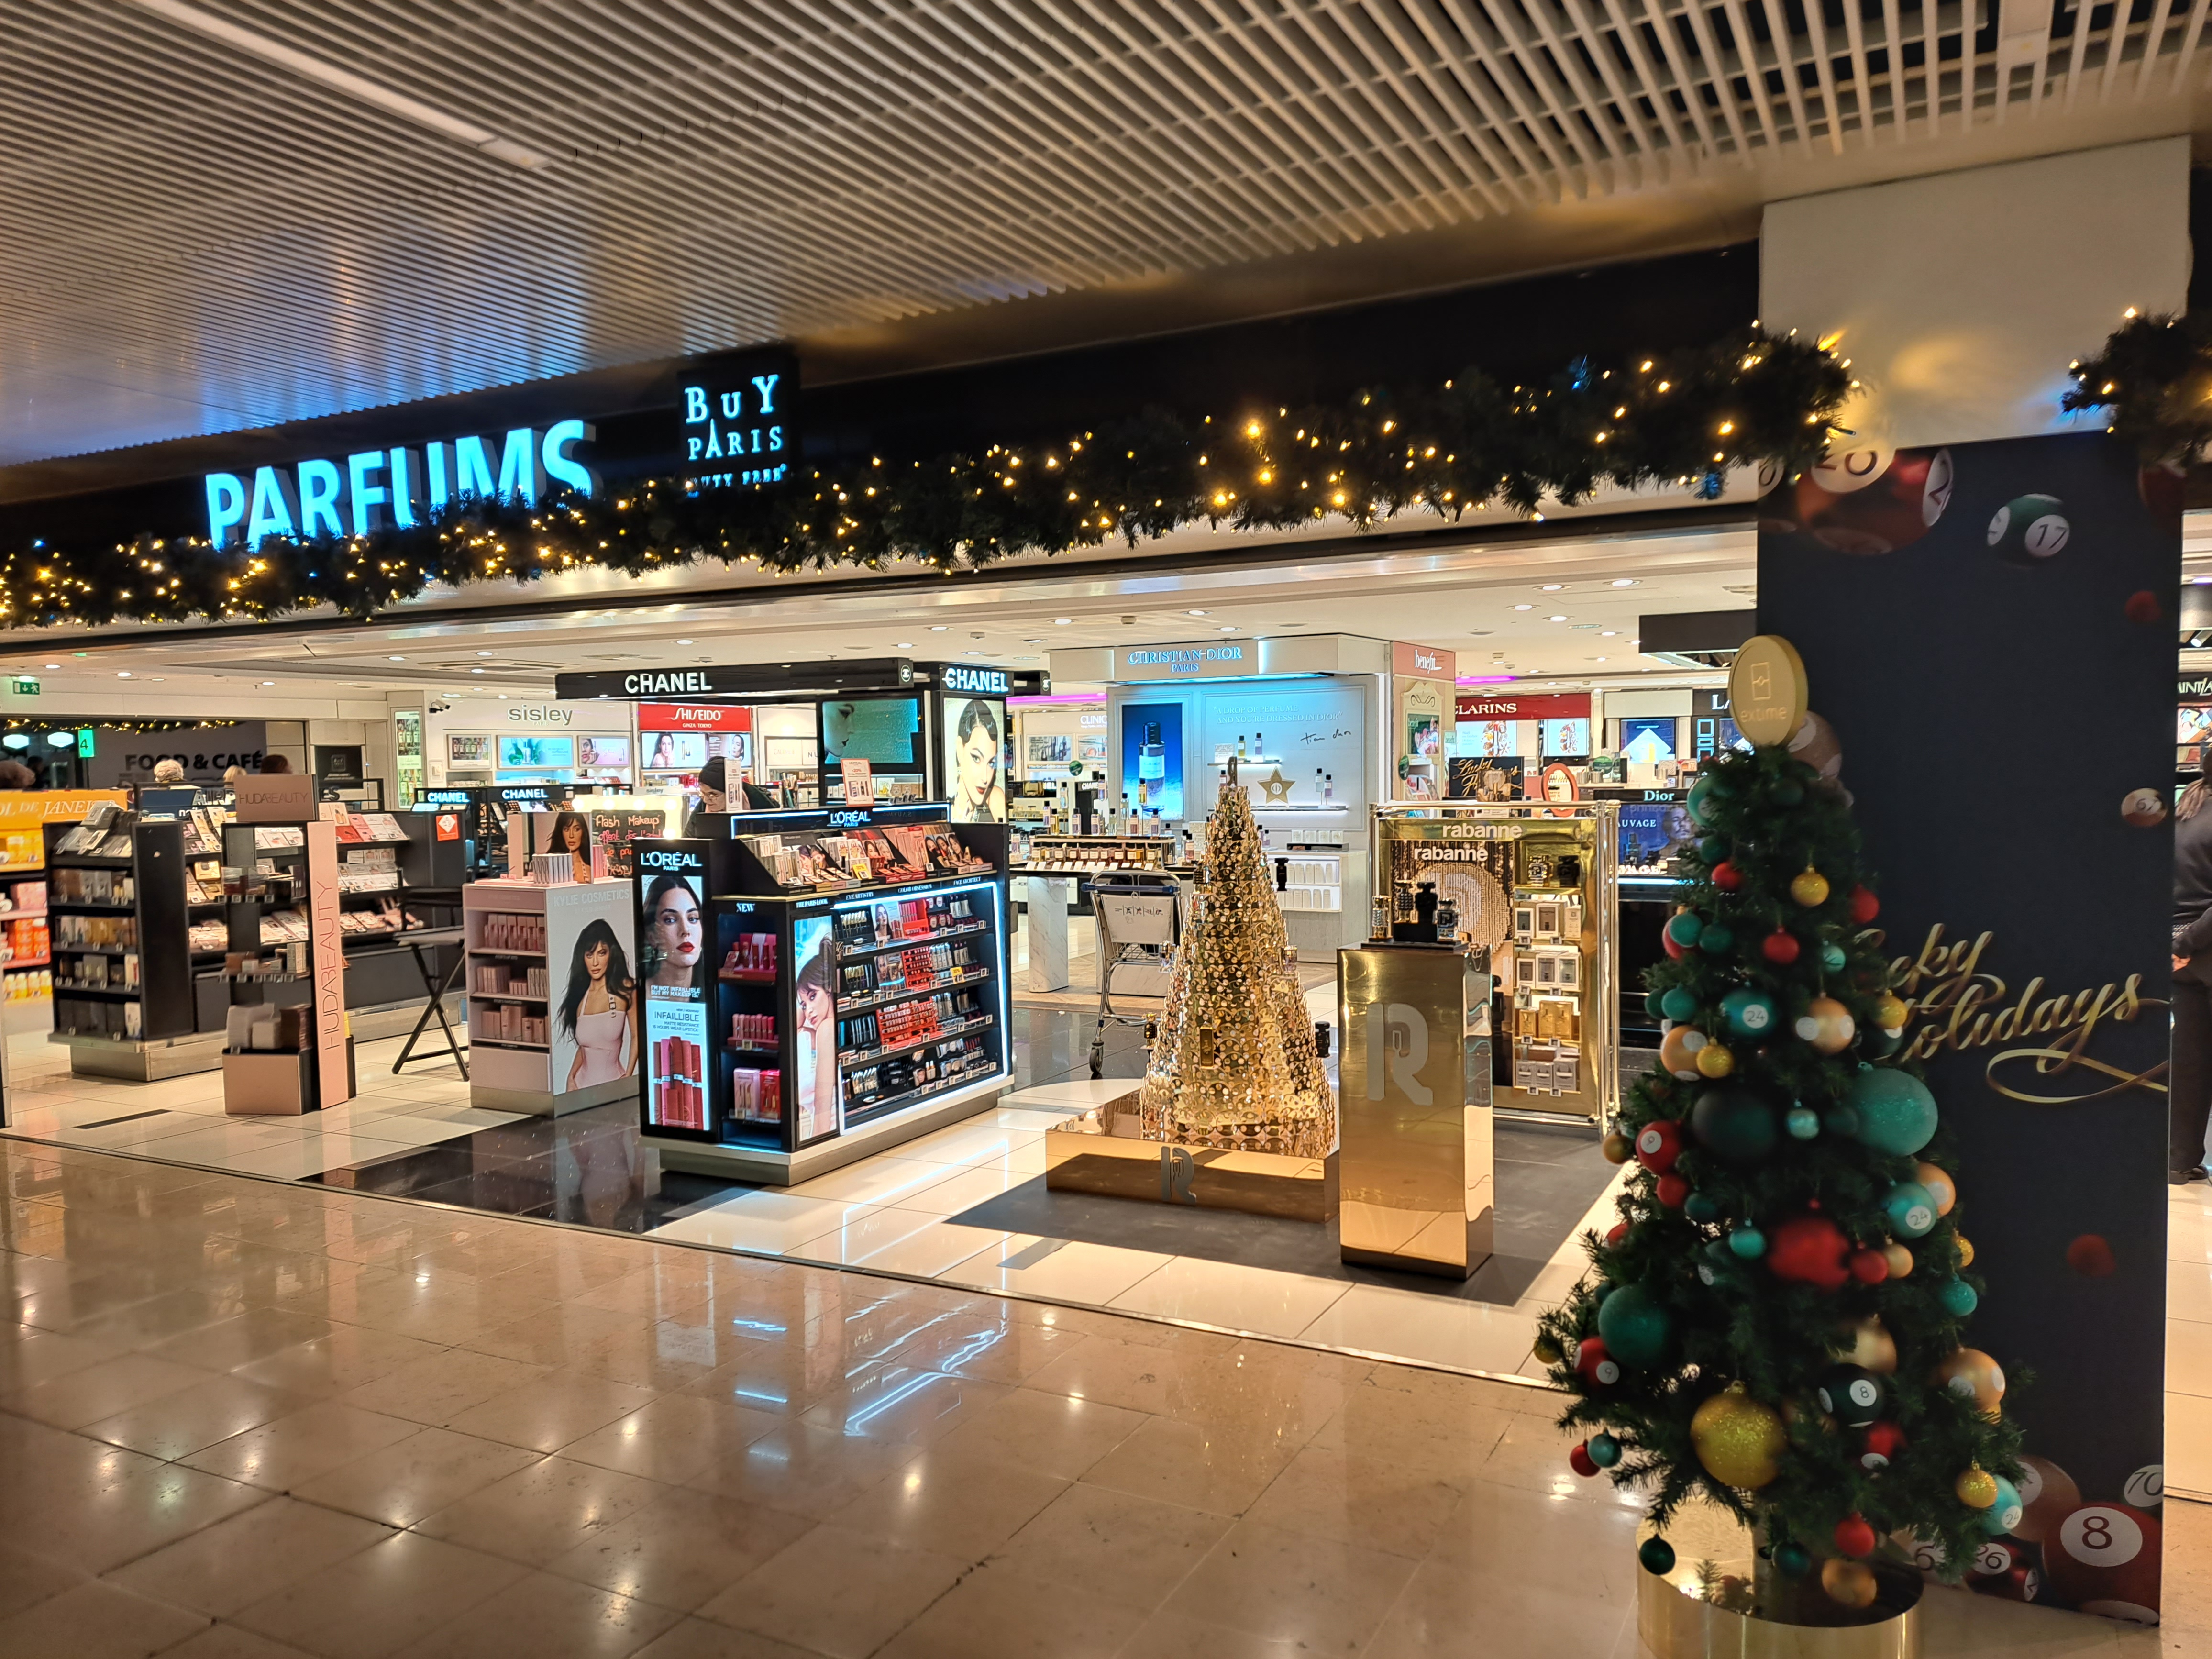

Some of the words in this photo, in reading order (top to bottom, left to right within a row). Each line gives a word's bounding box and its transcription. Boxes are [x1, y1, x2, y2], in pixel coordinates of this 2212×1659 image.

[687, 418, 782, 460] PARIS
[206, 420, 595, 552] PARFUMS
[2035, 523, 2067, 550] 17
[1128, 649, 1201, 664] CHRISTIAN
[1205, 647, 1243, 661] DIOR
[1415, 649, 1442, 674] benefit
[1171, 663, 1199, 673] PARIS
[625, 672, 712, 694] CHANEL
[945, 668, 1009, 692] CHANEL
[507, 704, 573, 726] sisley
[671, 708, 721, 721] SHISEIDO
[1223, 706, 1245, 715] DROP
[1247, 705, 1258, 713] OF
[1260, 704, 1298, 713] PERFUME
[1740, 706, 1788, 723] extime
[1217, 716, 1234, 724] AND
[1235, 715, 1264, 723] YOU'RE
[1266, 714, 1304, 722] DRESSED
[80, 738, 89, 750] 4
[193, 754, 209, 770] &
[212, 750, 263, 770] CAFÉ
[427, 792, 471, 803] CHANEL
[501, 788, 548, 799] CHANEL
[1644, 790, 1675, 801] Dior
[596, 815, 620, 828] Flash
[830, 810, 871, 824] L'ORÉAL
[1442, 823, 1523, 839] rabanne
[640, 851, 703, 867] L'ORÉAL
[1413, 846, 1489, 862] rabanne
[553, 895, 578, 907] KYLIE
[582, 889, 630, 903] COSMETICS
[735, 902, 755, 913] NEW
[654, 1011, 699, 1022] INFAILLIBLE
[1747, 1011, 1765, 1022] 24
[1860, 1386, 1869, 1398] 8
[2082, 1515, 2112, 1550] 8
